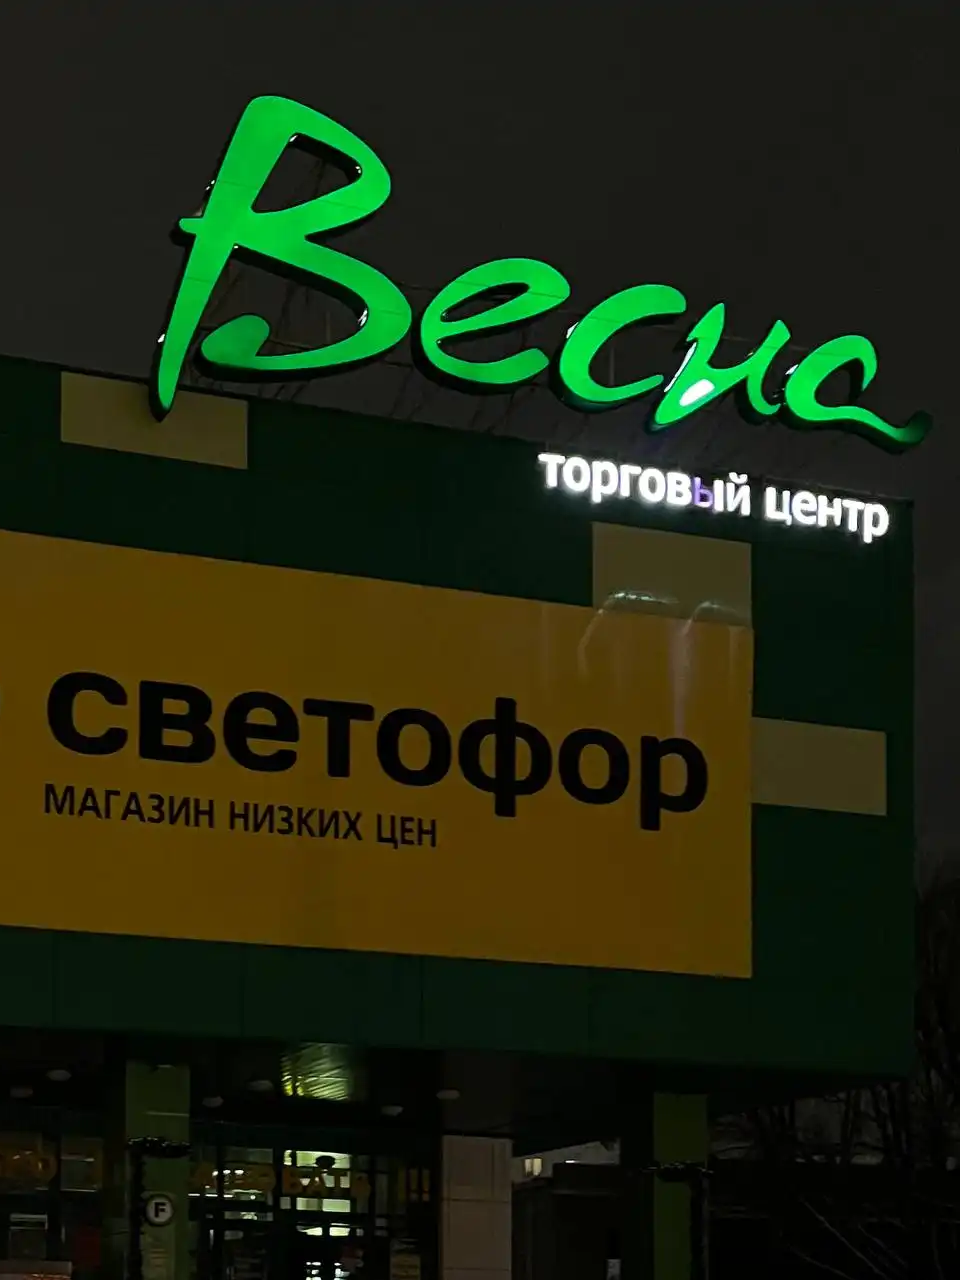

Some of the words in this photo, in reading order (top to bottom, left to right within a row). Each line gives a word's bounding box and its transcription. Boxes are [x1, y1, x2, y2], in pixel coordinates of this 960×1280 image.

[152, 94, 932, 452] Весна
[537, 452, 751, 517] торговый
[764, 485, 890, 544] центр
[46, 670, 707, 830] светофор
[44, 783, 215, 829] МАГАЗИН
[230, 800, 363, 841] НИЗКИХ
[376, 813, 437, 849] ЦЕН
